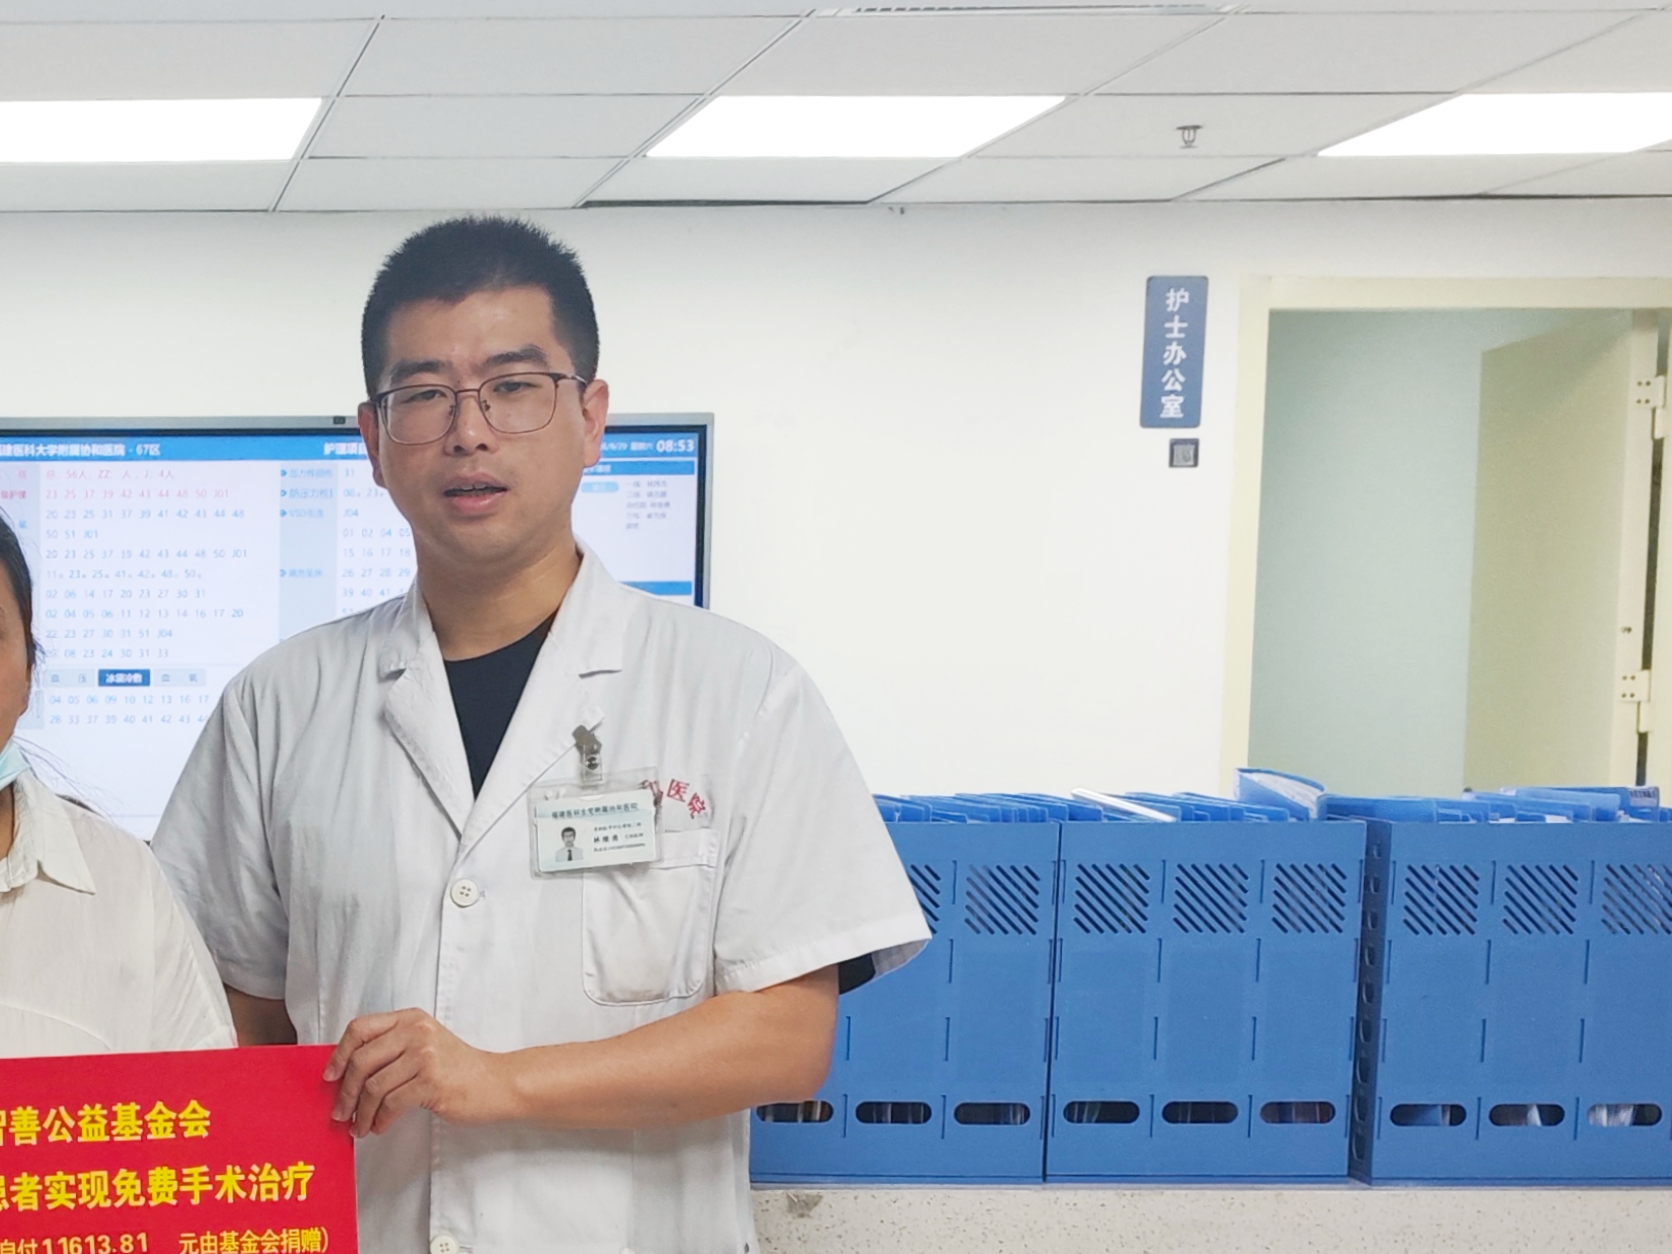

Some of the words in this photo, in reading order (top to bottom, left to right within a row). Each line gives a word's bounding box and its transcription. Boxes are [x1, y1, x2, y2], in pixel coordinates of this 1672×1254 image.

[1160, 288, 1189, 418] 护士办公室
[656, 439, 694, 453] 08:53
